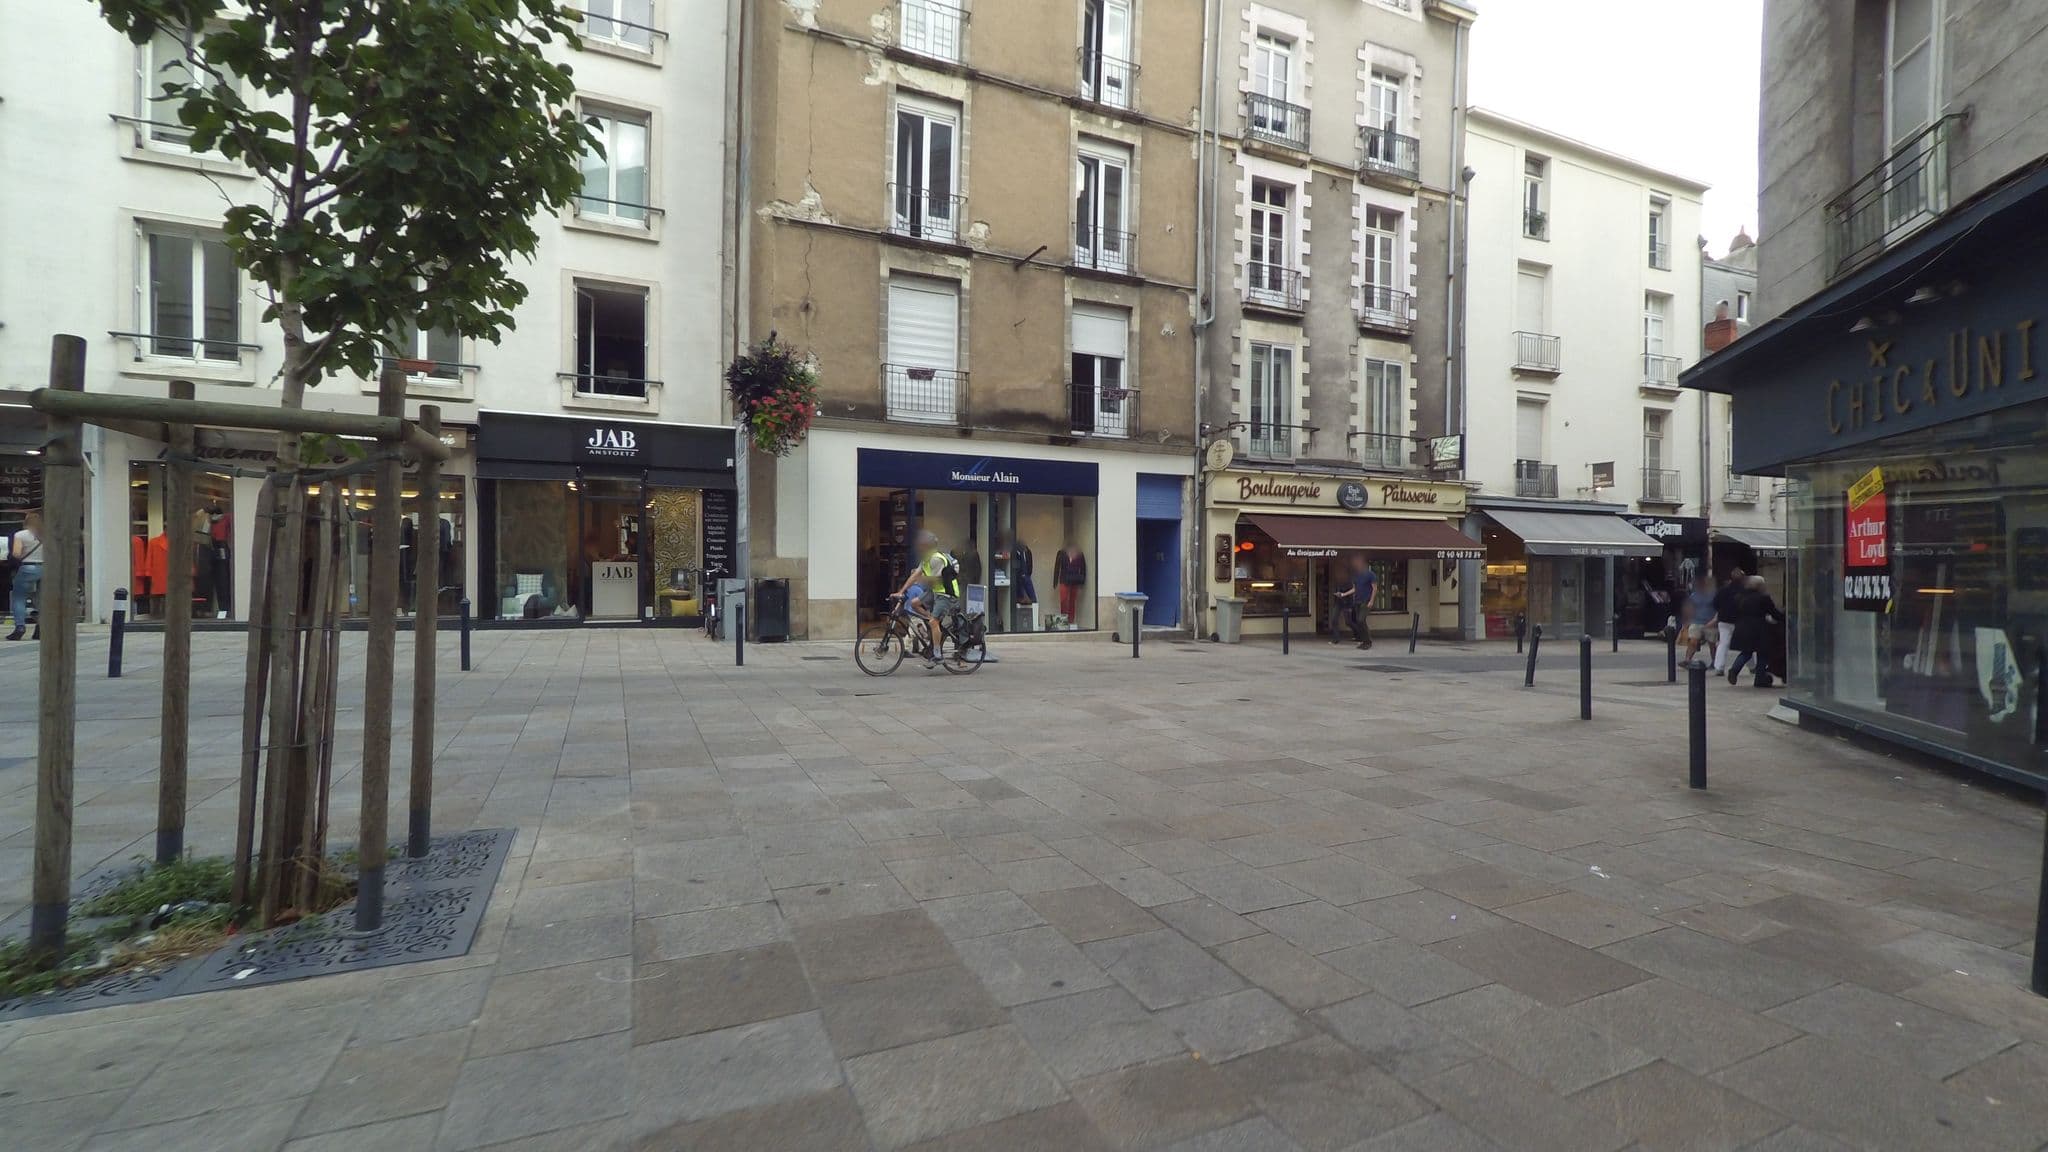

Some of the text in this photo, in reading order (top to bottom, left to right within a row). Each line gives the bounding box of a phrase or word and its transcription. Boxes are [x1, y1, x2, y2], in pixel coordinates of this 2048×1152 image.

[588, 428, 636, 449] JAB
[951, 470, 1020, 484] Monsieur Alain
[1236, 476, 1321, 504] Boulangerie
[1381, 484, 1438, 505] Pâtisserie
[1849, 517, 1886, 538] Arthur
[1860, 539, 1886, 564] Loyd
[602, 566, 633, 579] JAB
[1844, 576, 1854, 599] 02
[1854, 575, 1863, 599] 40
